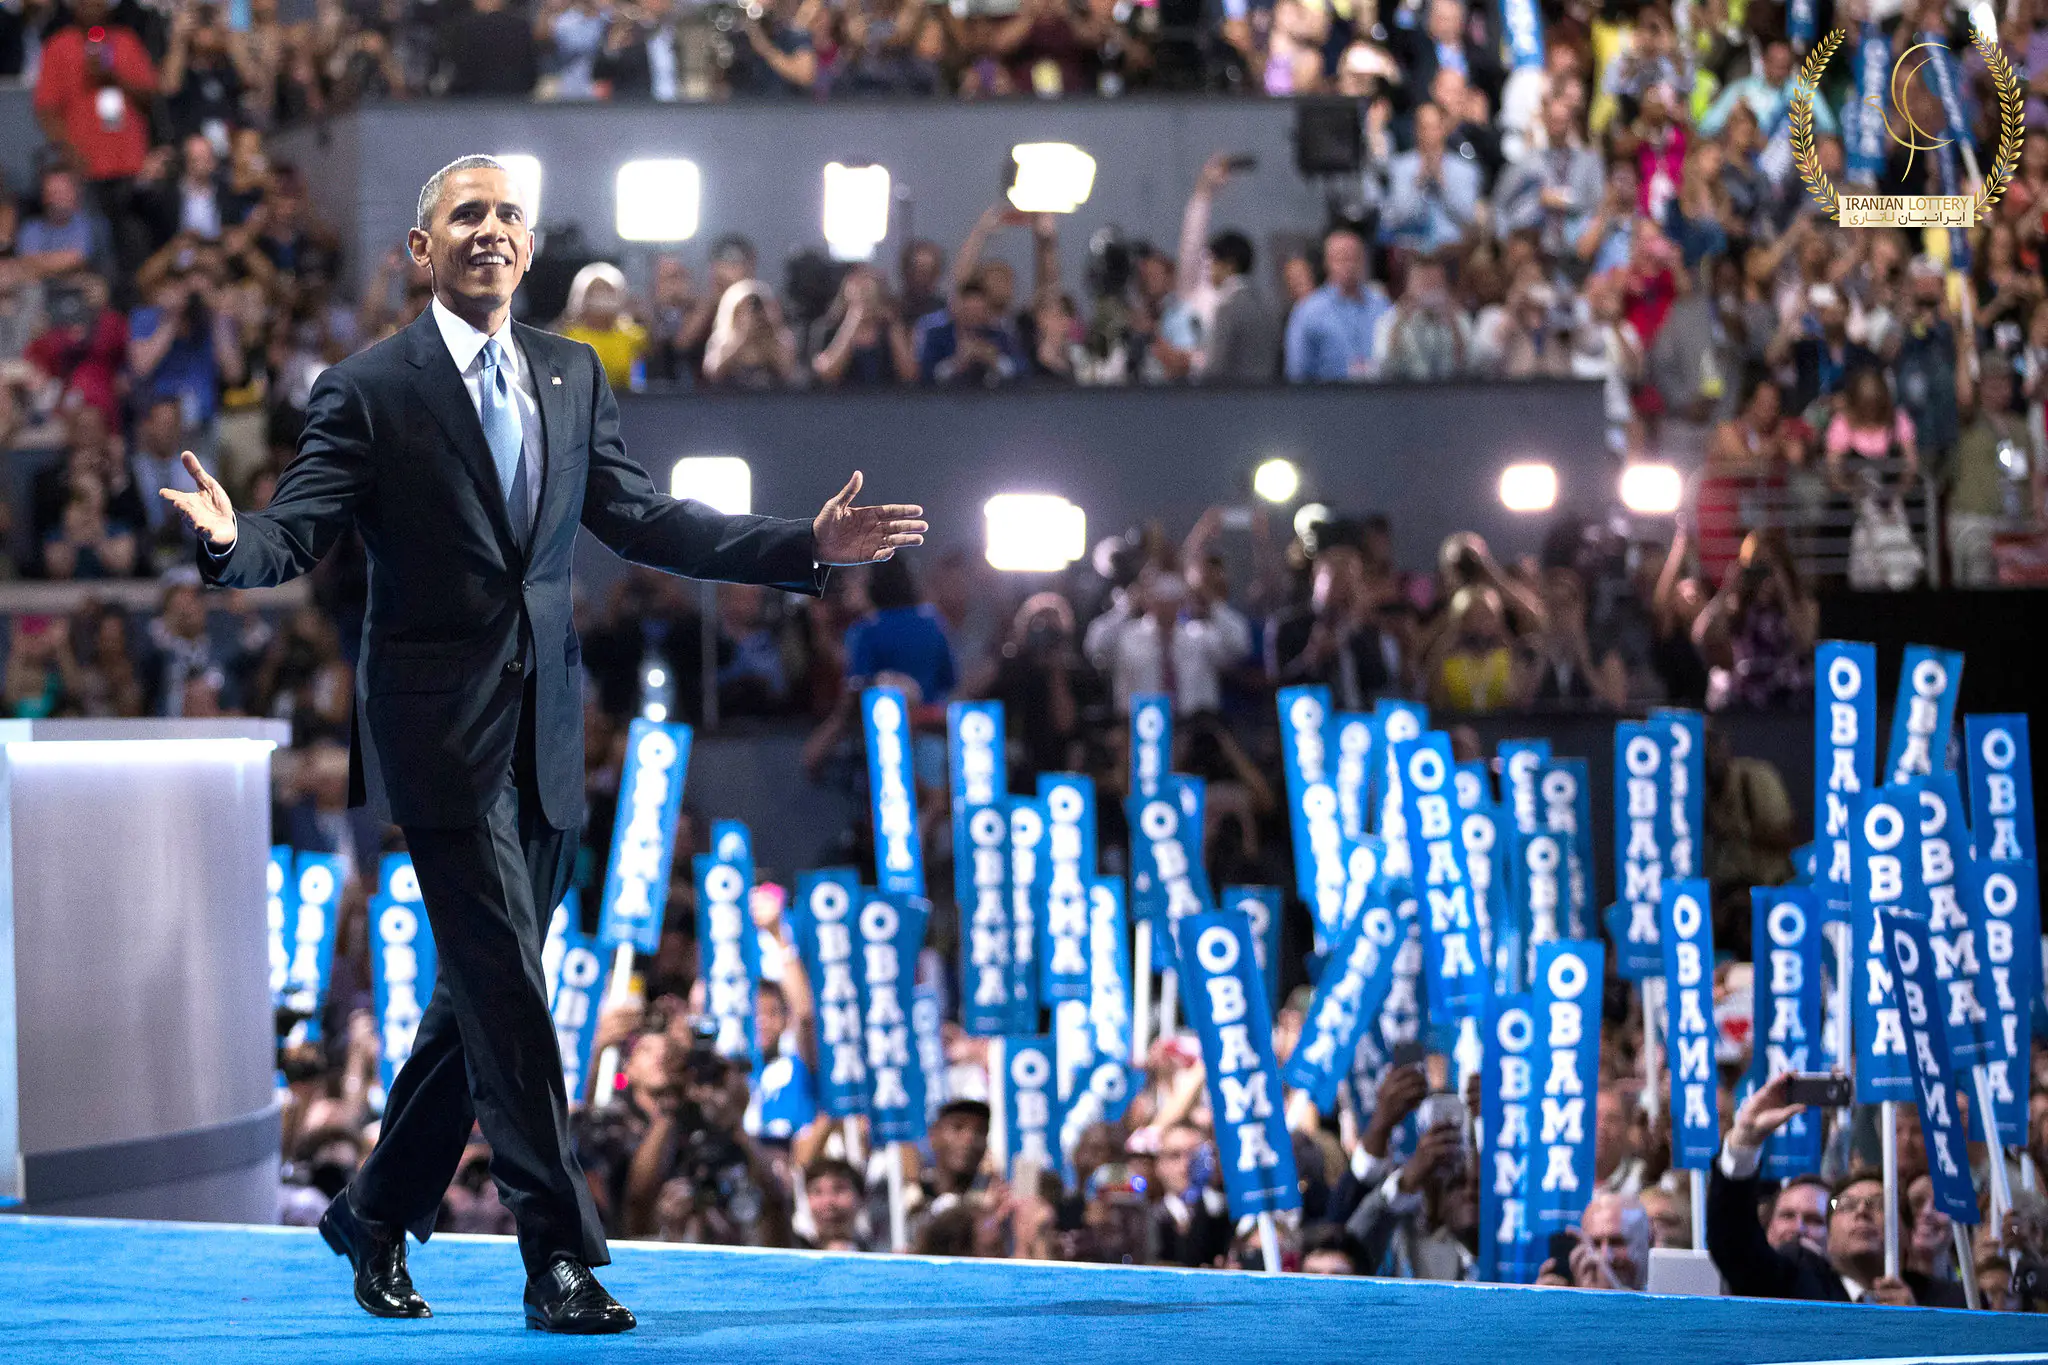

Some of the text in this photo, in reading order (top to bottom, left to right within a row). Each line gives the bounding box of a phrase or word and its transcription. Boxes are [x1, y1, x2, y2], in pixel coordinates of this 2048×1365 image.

[1894, 659, 1948, 785] OBA
[1408, 748, 1476, 978] OBAMA
[1196, 926, 1280, 1173] OBAMA
[1493, 1008, 1534, 1244] OBAMA
[1540, 953, 1588, 1192] OBAMA
[1672, 893, 1711, 1129] OBAMA
[1894, 929, 1958, 1178] OBAMA
